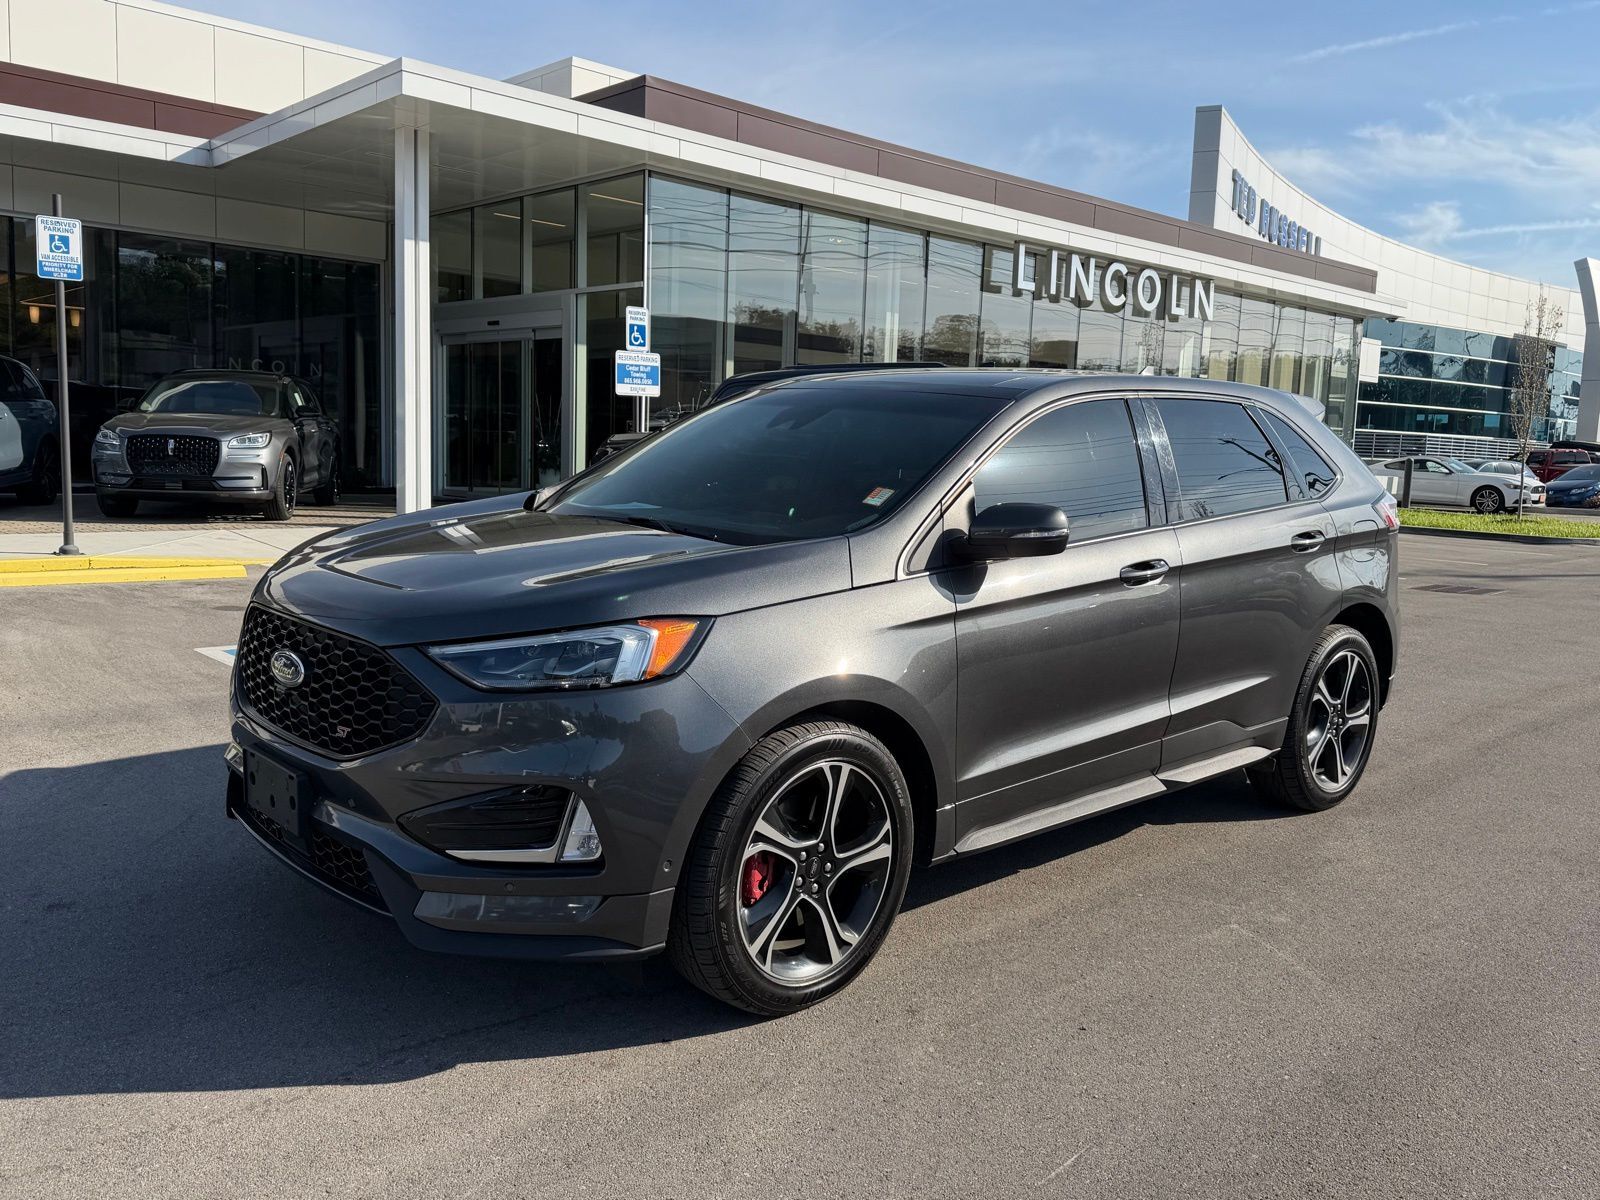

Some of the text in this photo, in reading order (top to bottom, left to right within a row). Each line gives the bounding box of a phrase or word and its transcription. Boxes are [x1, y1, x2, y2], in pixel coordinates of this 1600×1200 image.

[1232, 168, 1256, 226] TED
[40, 219, 77, 228] RESERVED
[43, 225, 75, 234] PARKING
[51, 254, 79, 263] ACCESSIBLE
[1013, 240, 1215, 321] LINCOLN
[193, 353, 322, 377] LNCOLN
[630, 371, 647, 379] Towing
[336, 725, 352, 738] ST
